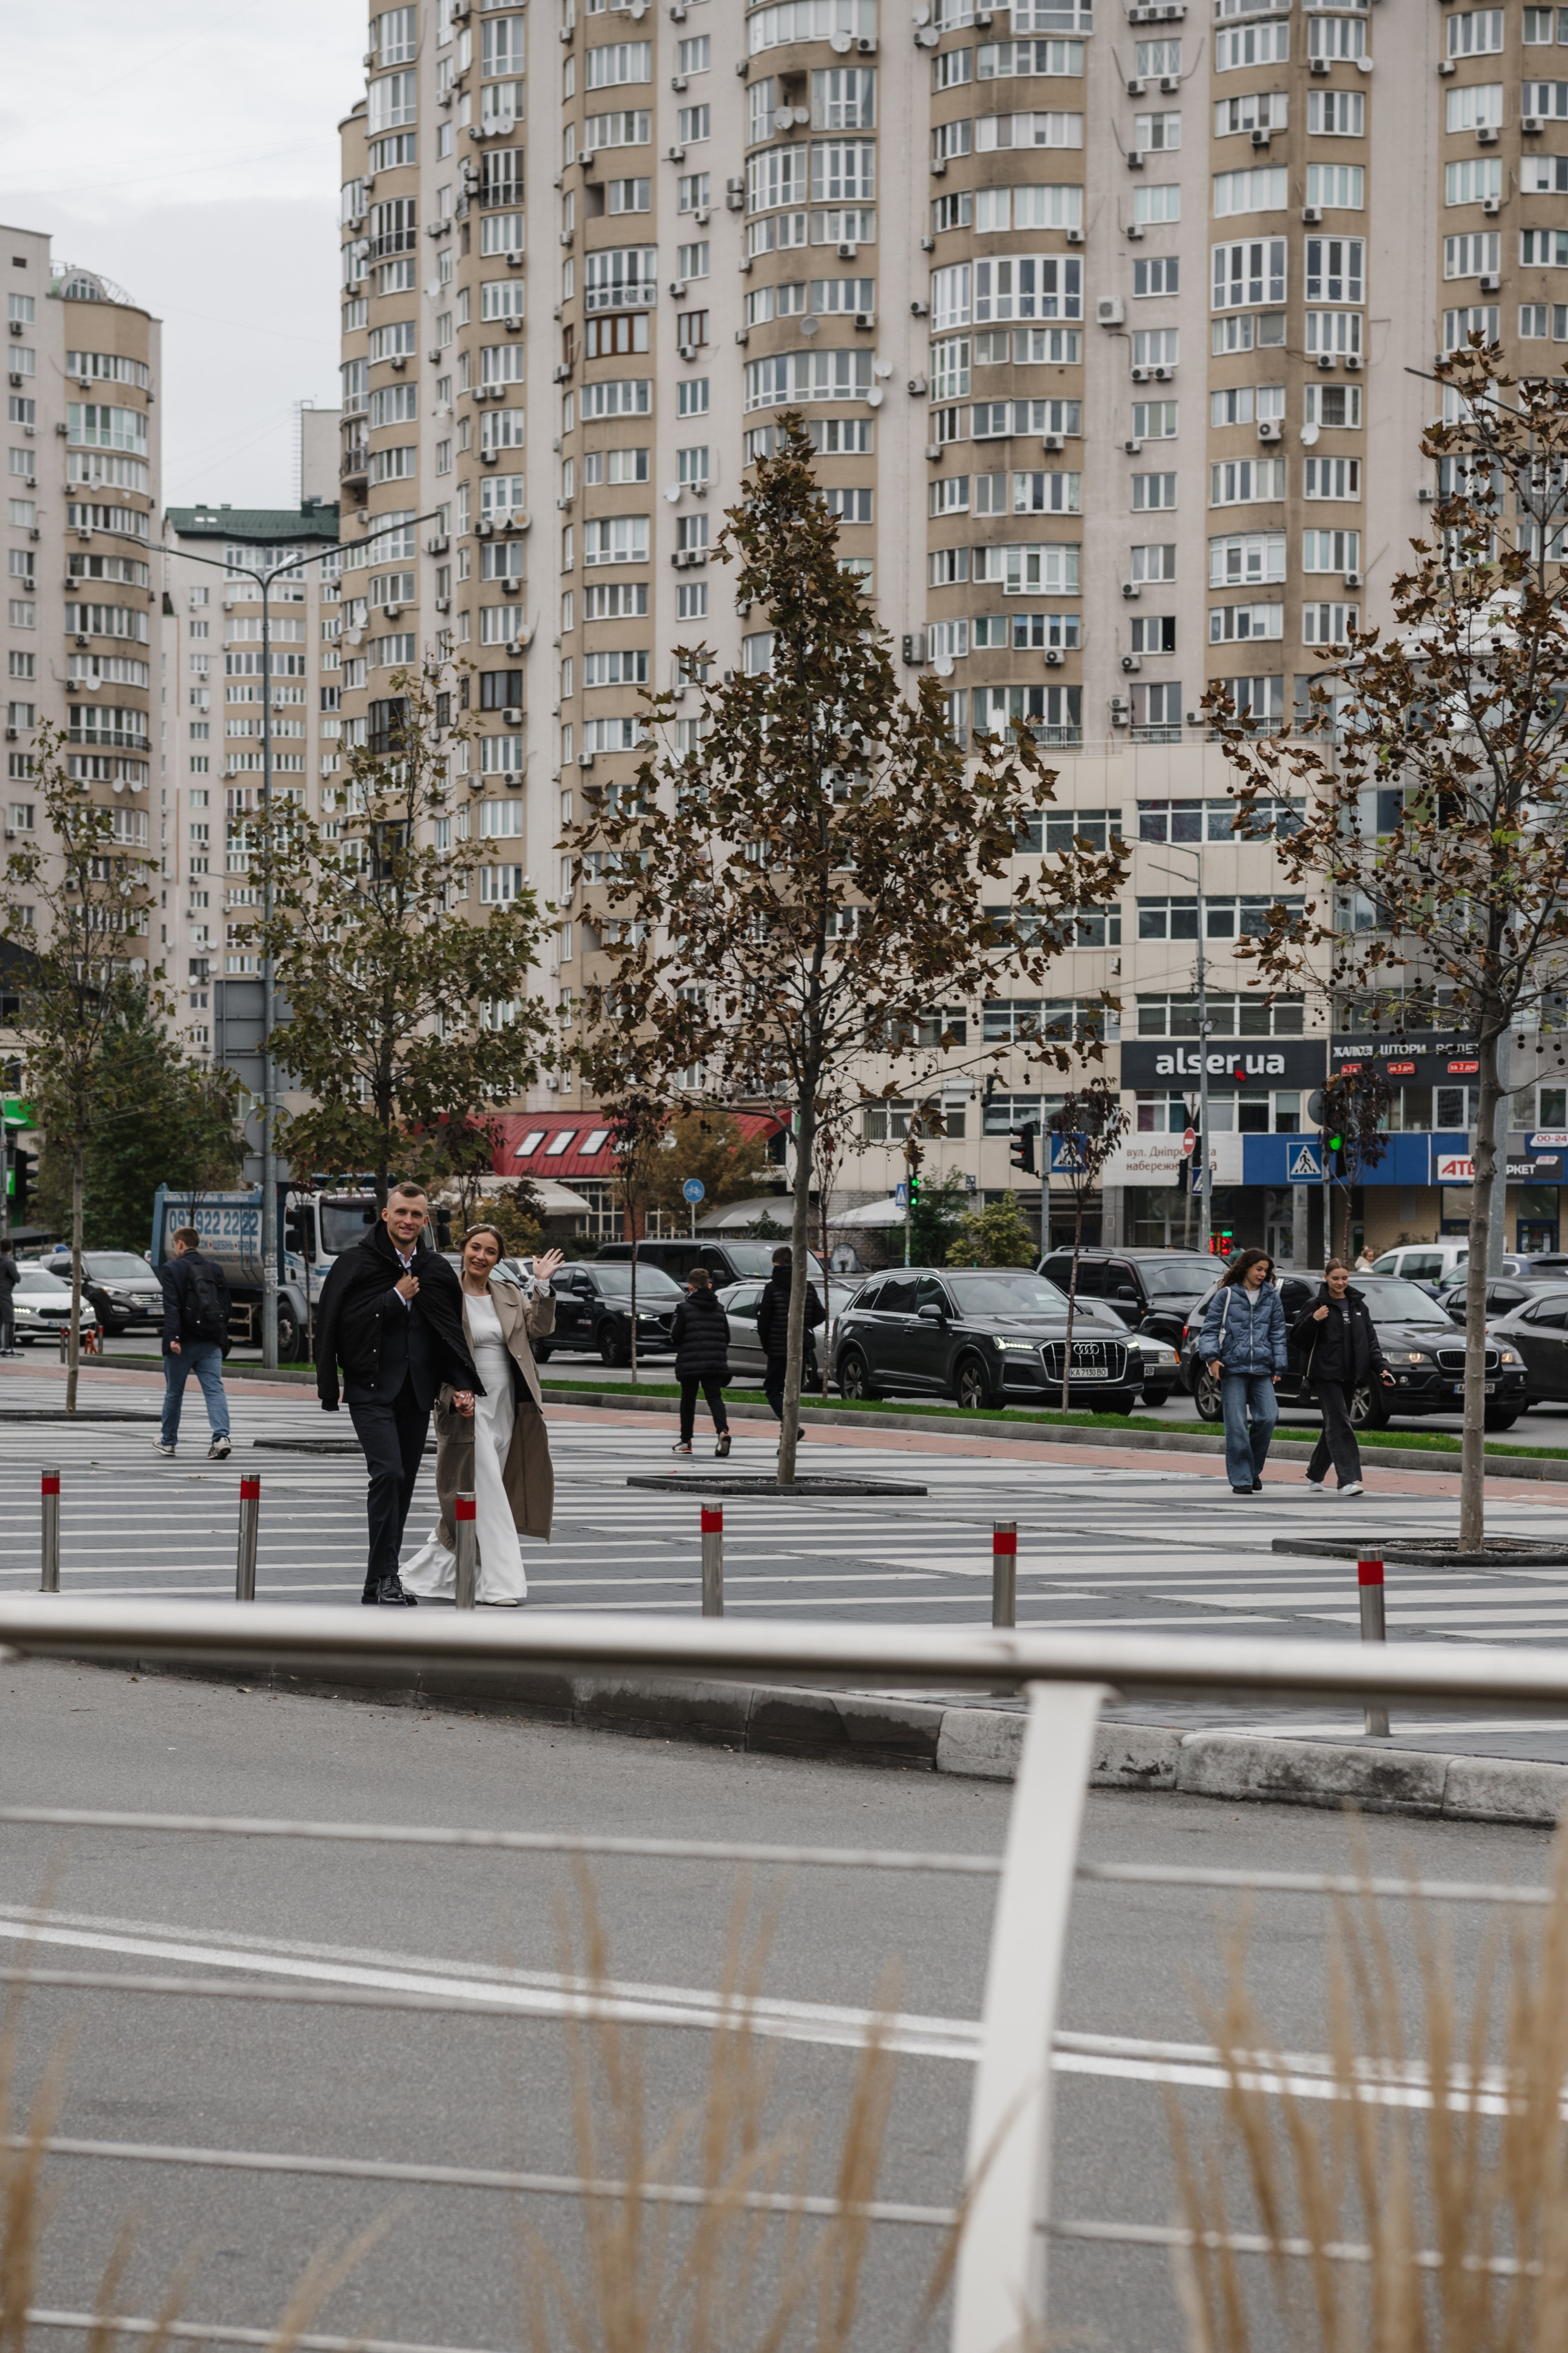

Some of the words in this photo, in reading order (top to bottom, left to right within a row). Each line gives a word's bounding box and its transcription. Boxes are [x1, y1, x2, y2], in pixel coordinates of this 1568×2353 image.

[1380, 1044, 1426, 1055] ШТОРИ
[1126, 1149, 1146, 1158] вул.
[1506, 1165, 1536, 1174] РКЕТ
[195, 1211, 221, 1235] 922
